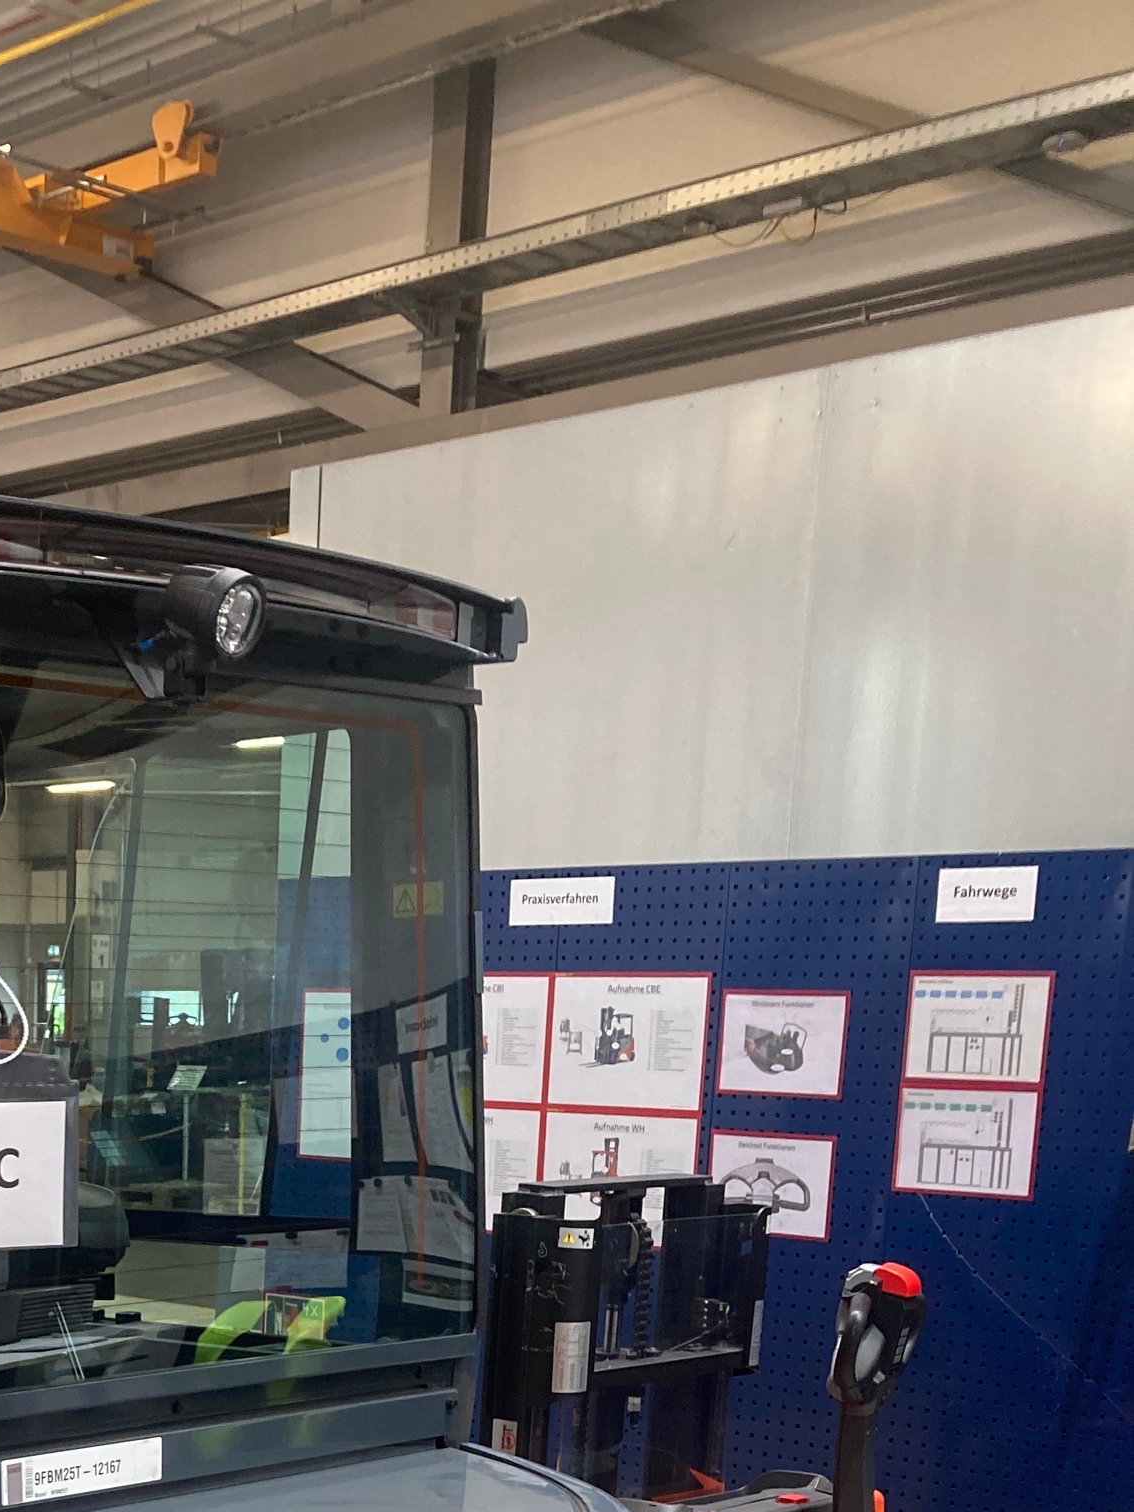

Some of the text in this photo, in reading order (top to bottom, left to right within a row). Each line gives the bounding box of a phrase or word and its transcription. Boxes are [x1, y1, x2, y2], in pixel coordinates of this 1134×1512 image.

[954, 884, 1018, 900] Fahrwege
[522, 892, 599, 905] Praxisverfahren
[607, 984, 645, 994] Aufnahme
[594, 1122, 646, 1133] Aufnahme WH
